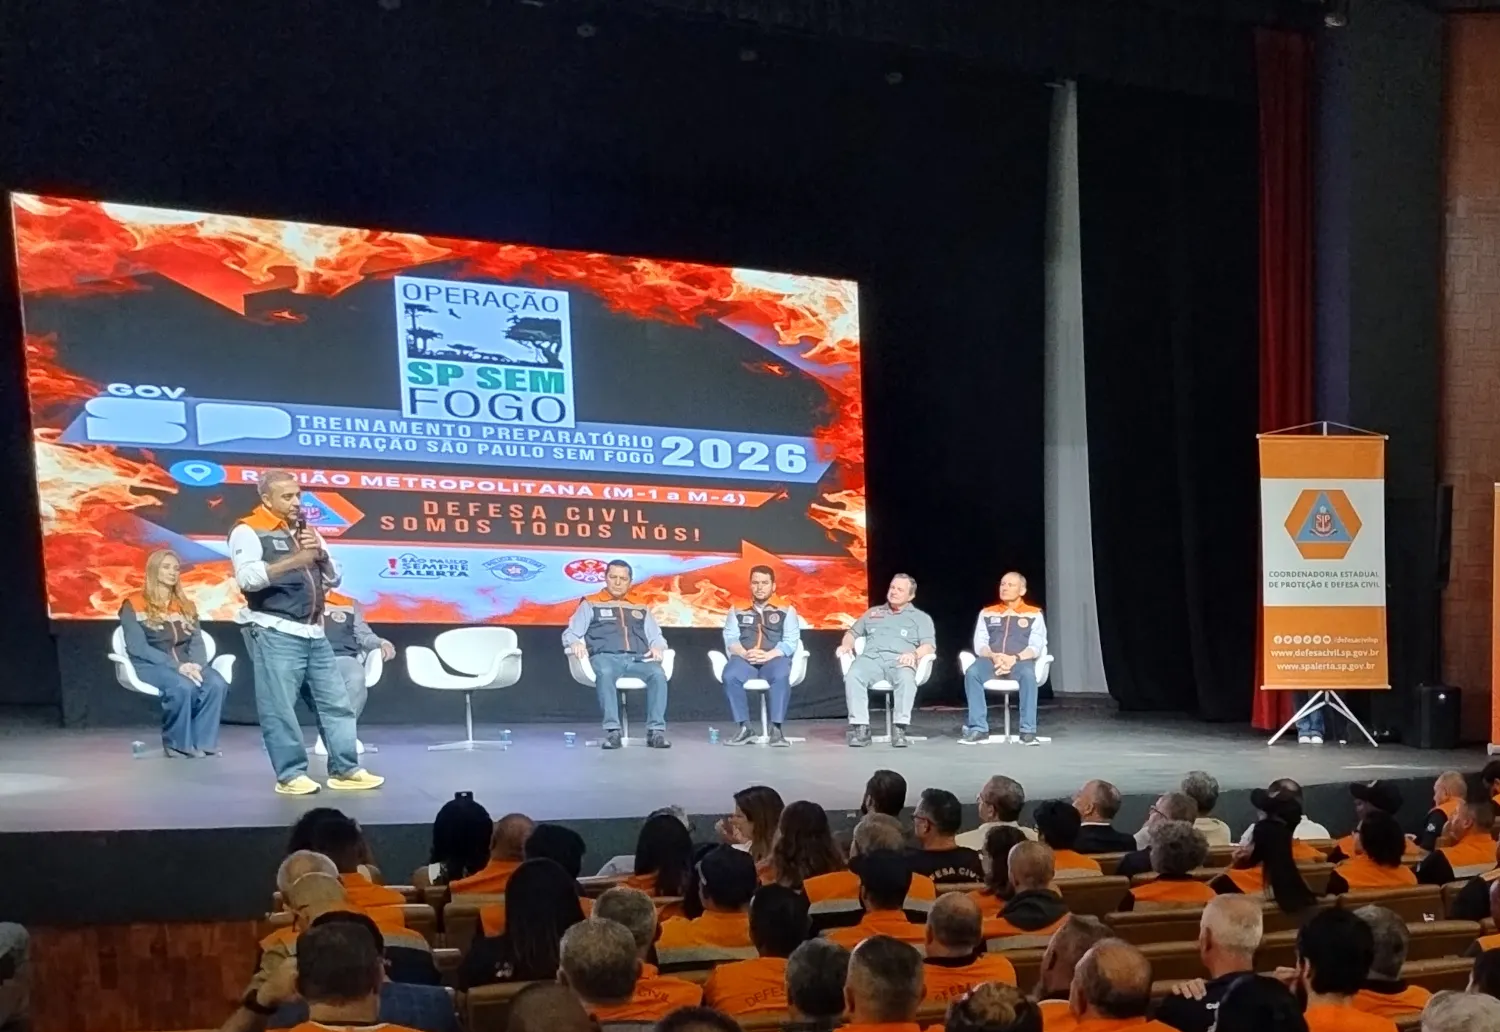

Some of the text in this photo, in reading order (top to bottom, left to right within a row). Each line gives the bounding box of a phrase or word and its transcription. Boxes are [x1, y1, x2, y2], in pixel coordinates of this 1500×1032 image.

[402, 283, 559, 313] OPERAÇÃO
[407, 361, 565, 394] SP SEM
[107, 383, 186, 400] GOV
[408, 387, 567, 424] FOGO
[296, 414, 654, 449] TREINAMENTO PREPARATÓRIO
[298, 433, 655, 465] OPERAÇÃO SÃO PAULO SEM FOGO
[660, 435, 808, 474] 2026
[240, 469, 746, 505] RIÃO METROPOLITANA (M-1 a M-4)
[423, 500, 650, 524] DEFESA CIVIL
[380, 516, 701, 541] SOMOS TODOS NÓS!
[402, 563, 469, 571] SEMPRE
[1268, 570, 1380, 578] COORDENADORIA ESTADUAL
[1268, 581, 1279, 589] DE
[1280, 580, 1322, 590] PROTEÇÃO
[1324, 581, 1329, 589] E
[1330, 581, 1360, 589] DEFESA
[1270, 648, 1380, 658] www.defesacivil.sp.gov.br
[1276, 661, 1376, 672] www.spalerta.sp.gov.br
